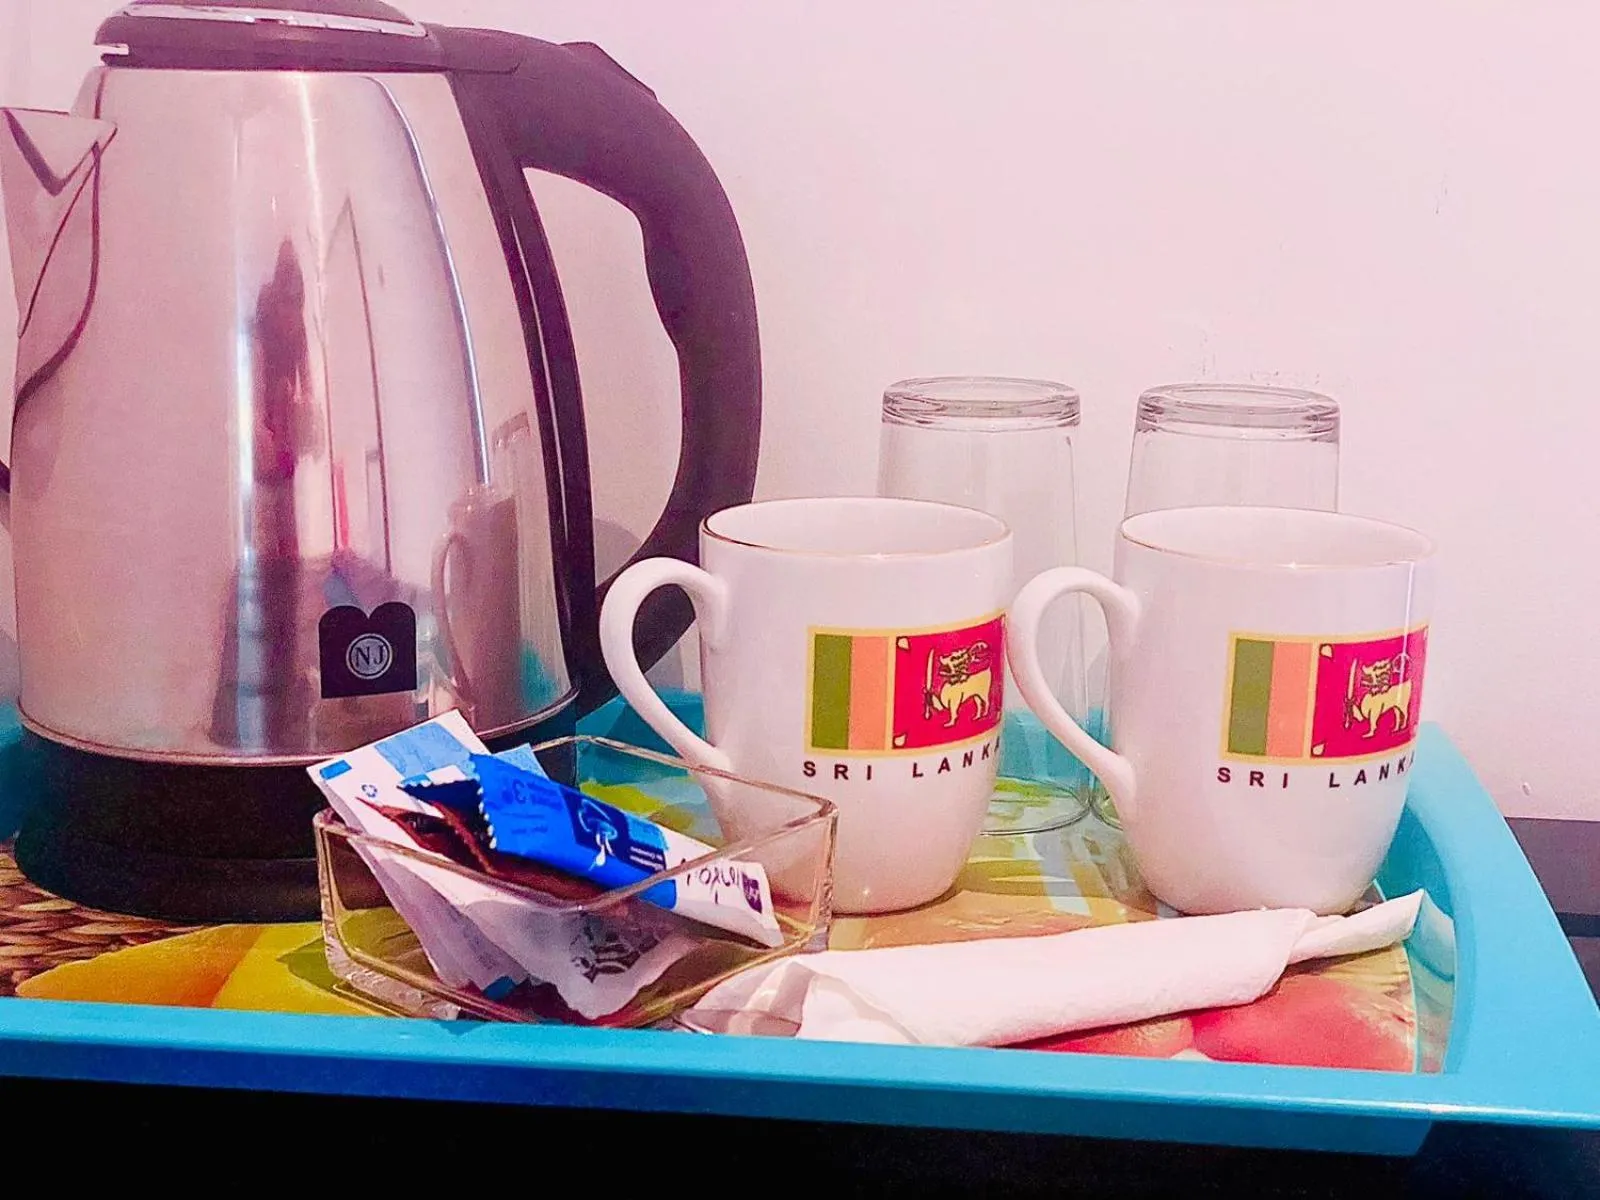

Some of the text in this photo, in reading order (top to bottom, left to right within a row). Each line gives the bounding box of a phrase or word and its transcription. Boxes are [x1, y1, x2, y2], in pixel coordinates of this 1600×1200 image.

[354, 644, 385, 668] NJ
[803, 761, 872, 781] SRI
[1217, 767, 1288, 789] SRI
